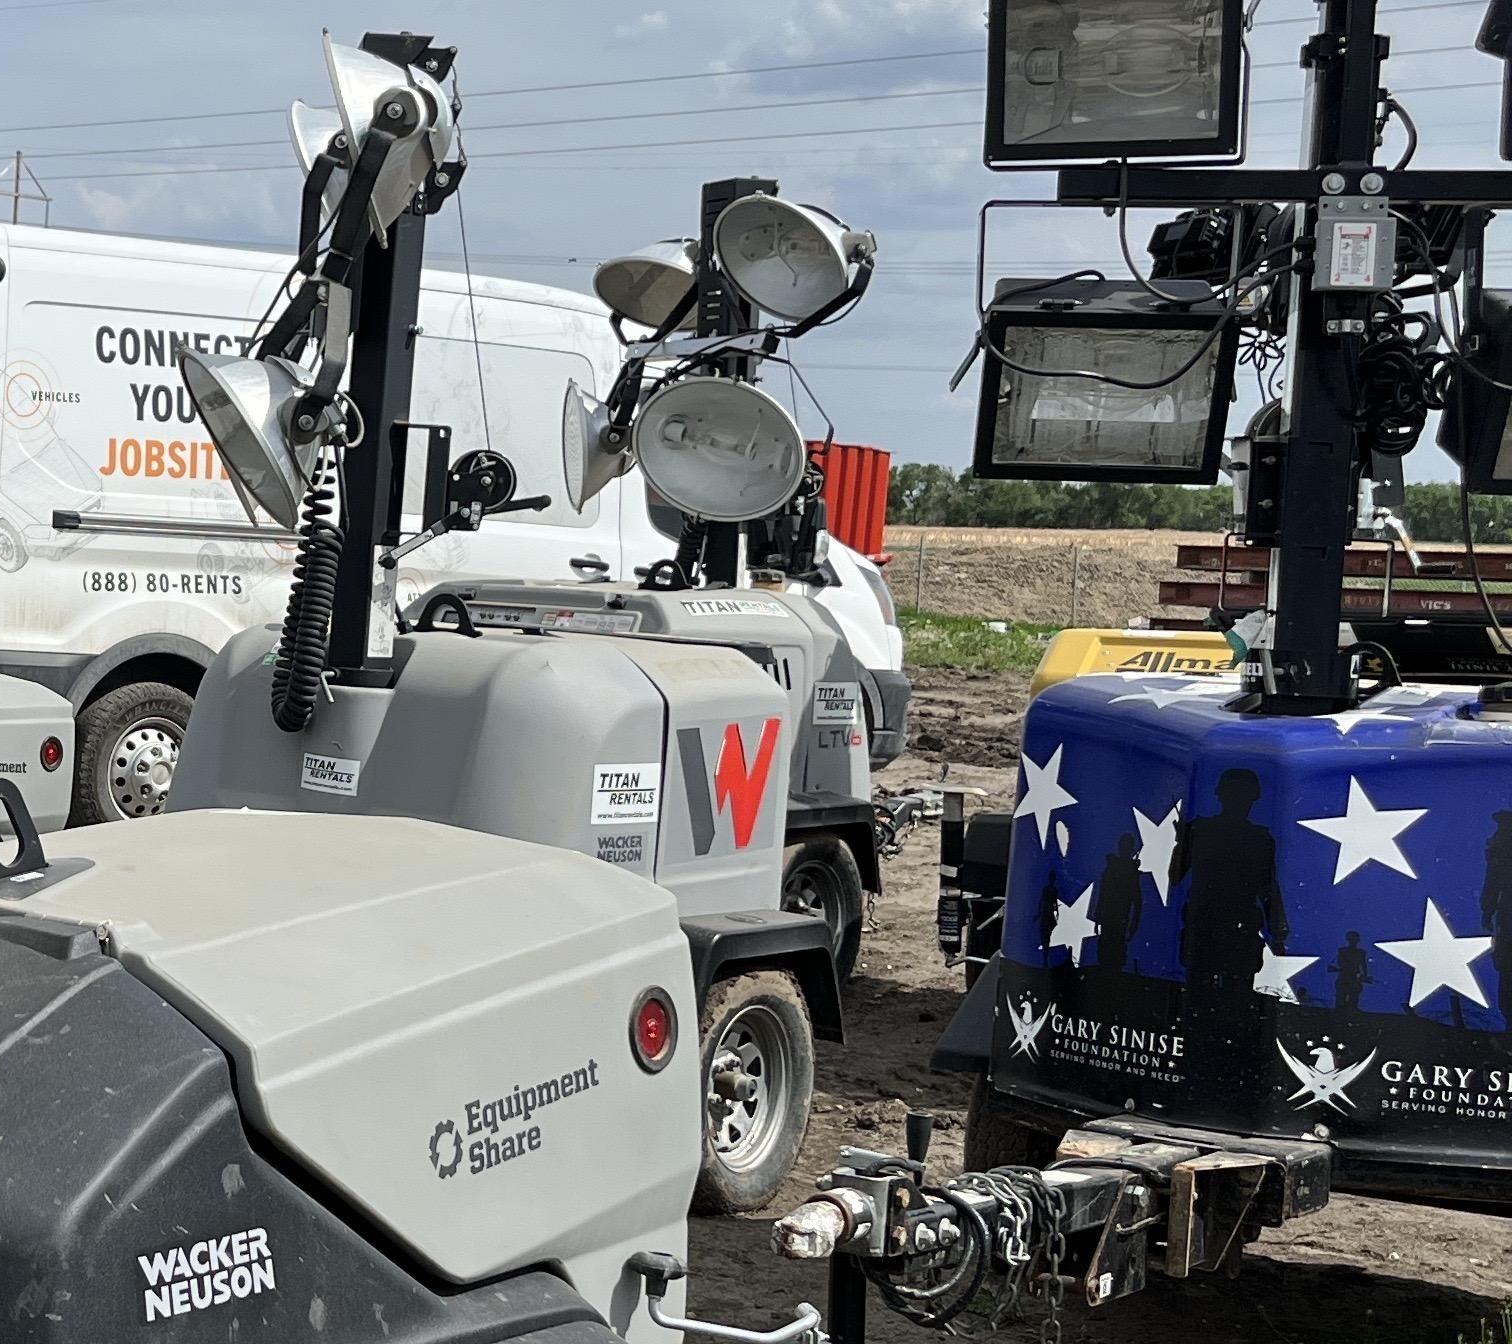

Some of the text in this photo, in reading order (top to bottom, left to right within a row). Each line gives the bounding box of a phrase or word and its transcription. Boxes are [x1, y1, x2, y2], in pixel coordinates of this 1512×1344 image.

[31, 390, 81, 404] VEHICLES
[129, 382, 197, 424] YOU
[99, 437, 230, 481] JOBSIT
[82, 570, 243, 596] (888) 80-RENTS
[679, 600, 742, 614] TITAN
[1116, 651, 1233, 673] Allma
[818, 687, 846, 699] TITAN
[305, 756, 337, 771] TITAN
[309, 769, 353, 784] RENTALS
[599, 772, 641, 789] TITAN
[609, 791, 655, 806] RENTALS
[597, 835, 643, 850] WACKER
[596, 849, 642, 863] NEUSON
[1051, 1013, 1185, 1058] GARY SINISE
[1049, 1049, 1085, 1064] SERVING
[1088, 1058, 1122, 1072] HONOR
[1126, 1065, 1146, 1076] AND
[1063, 1038, 1161, 1069] FOUNDATION
[1381, 1060, 1474, 1089] GARY
[464, 1058, 600, 1136] Equipment
[1409, 1086, 1511, 1108] FOUNDA
[1381, 1099, 1506, 1119] SERVING HONOR
[468, 1125, 542, 1175] Share
[137, 1226, 272, 1287] WACKER
[143, 1258, 276, 1322] NEUSON
